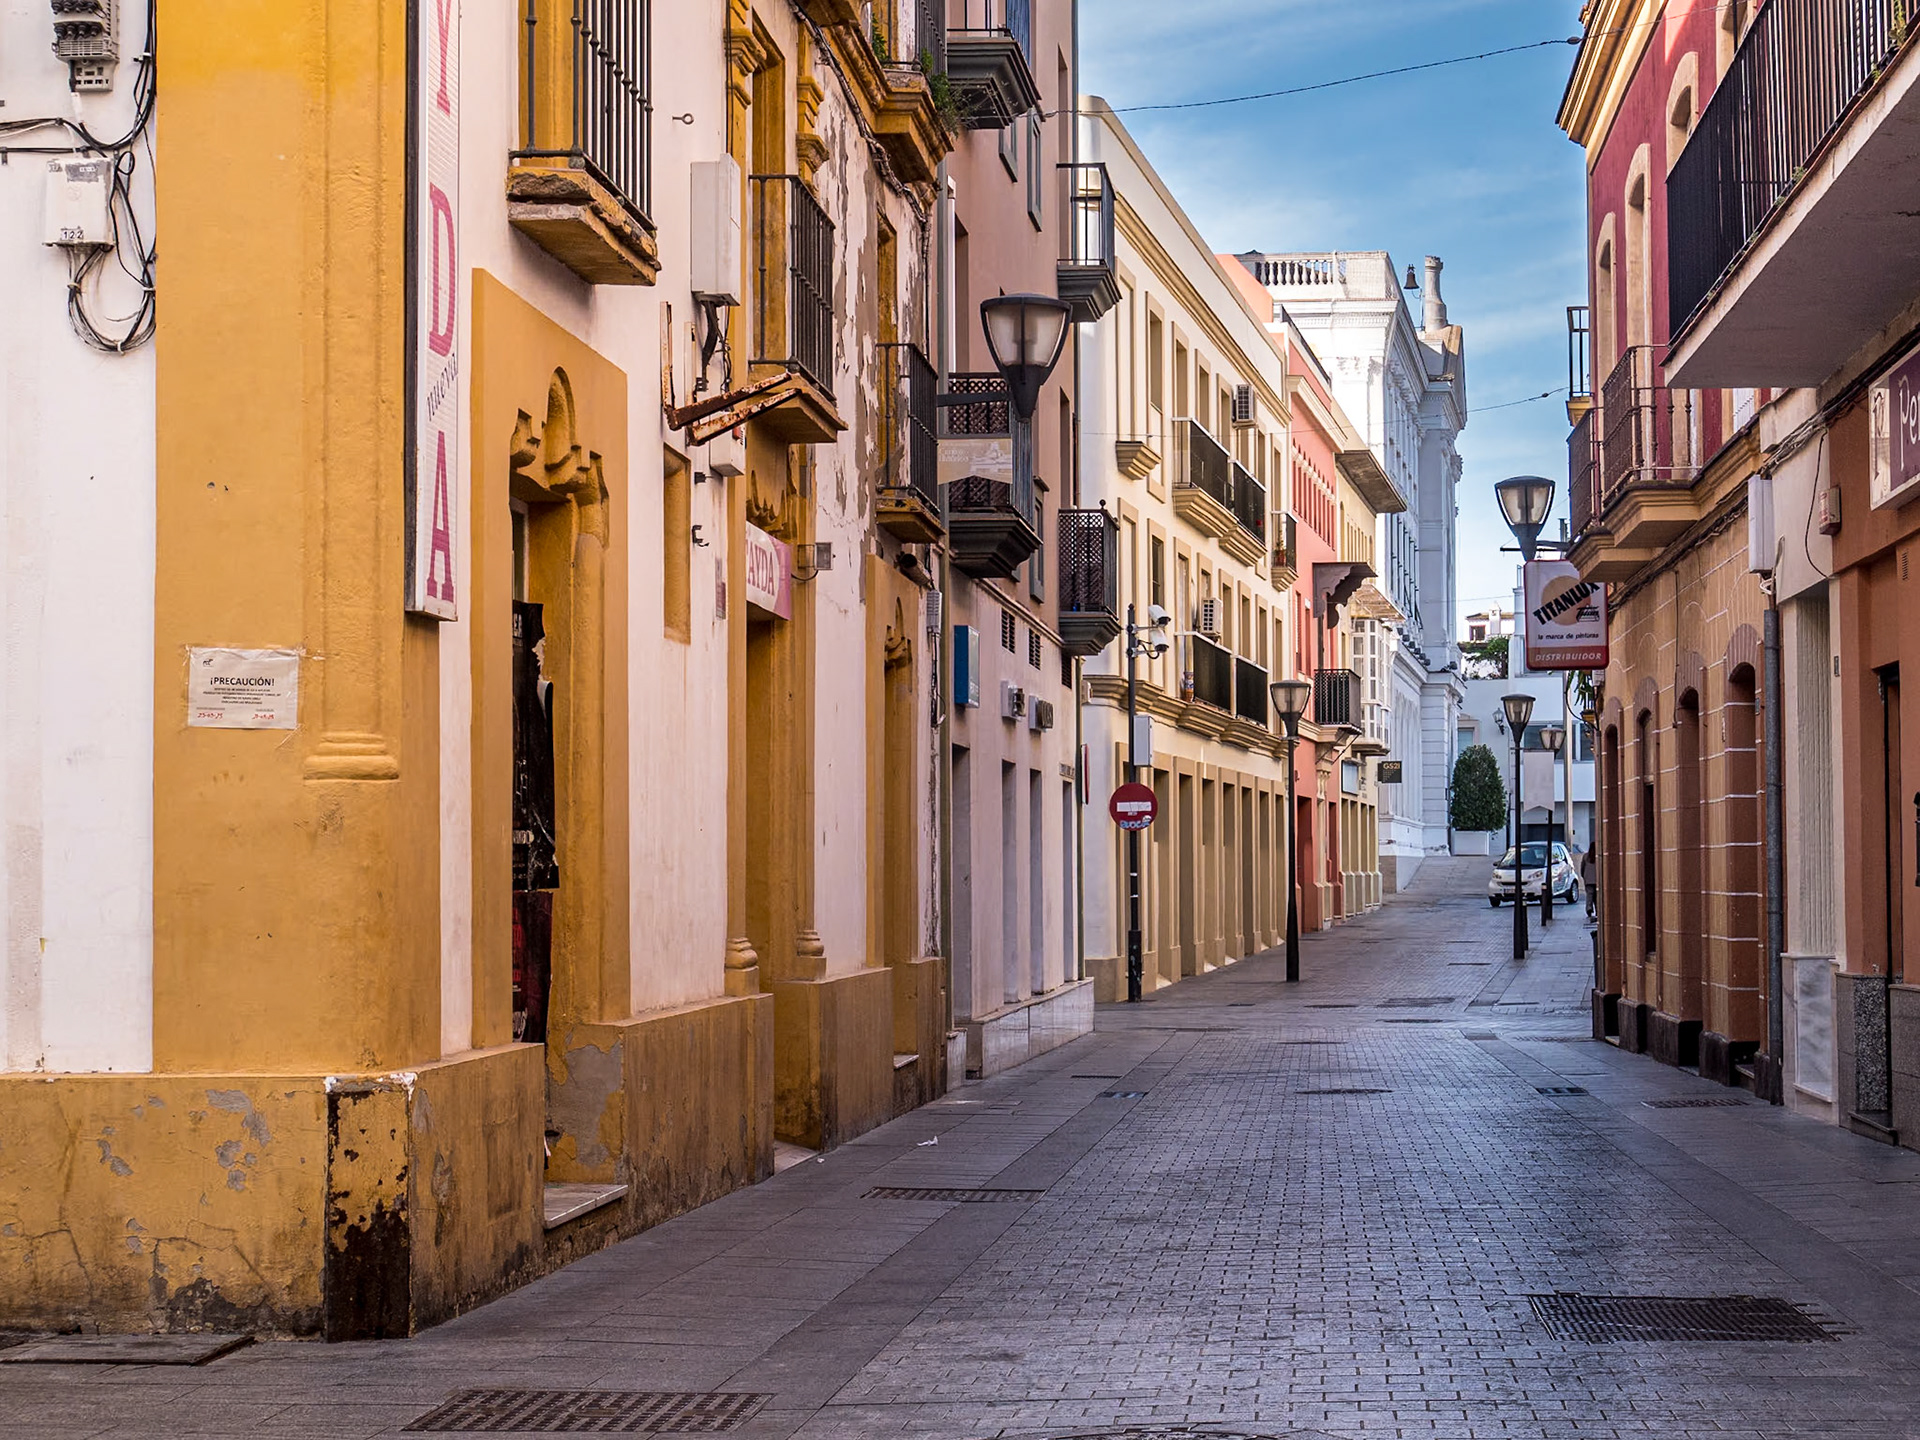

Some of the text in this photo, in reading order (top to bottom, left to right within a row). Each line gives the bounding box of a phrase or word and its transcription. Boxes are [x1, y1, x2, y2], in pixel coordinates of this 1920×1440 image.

[1533, 581, 1600, 625] TITANLUX
[1575, 632, 1599, 640] pinturas
[1535, 652, 1602, 661] DISTRIBUIDOR
[210, 676, 275, 687] ¡PRECAUCIÓN!
